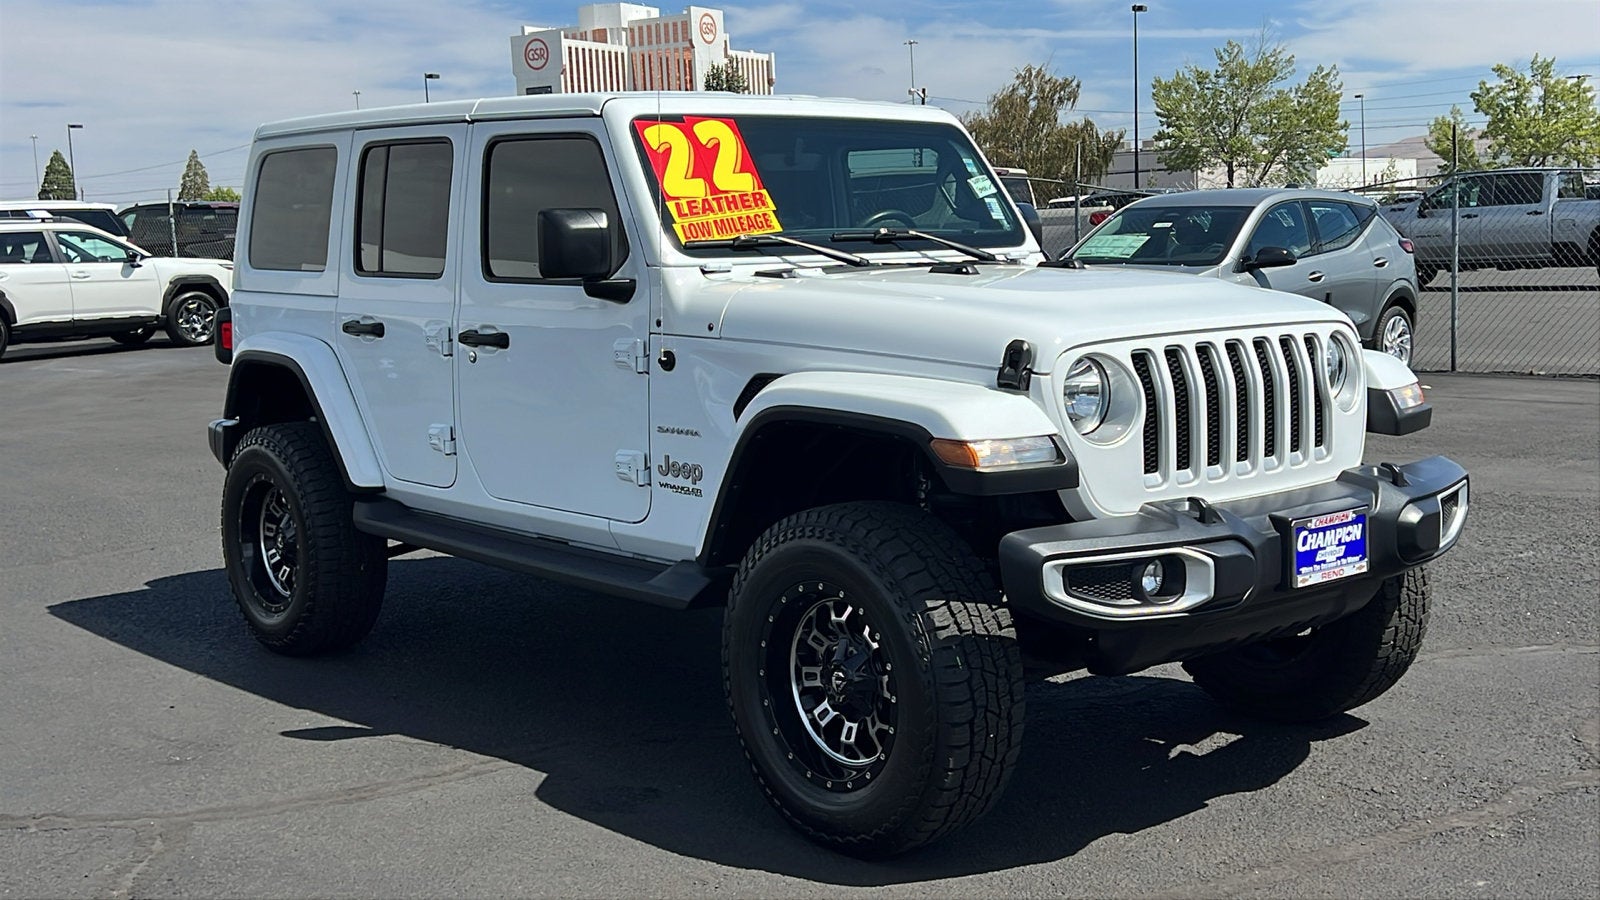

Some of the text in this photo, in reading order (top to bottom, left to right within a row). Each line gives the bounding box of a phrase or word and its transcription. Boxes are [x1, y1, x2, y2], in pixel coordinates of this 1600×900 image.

[701, 23, 715, 36] GSR
[527, 49, 546, 62] GSR
[643, 119, 757, 198] 22
[674, 191, 768, 219] LEATHER
[681, 212, 774, 241] LOW MILEAGE
[657, 425, 702, 437] SAHARA
[657, 454, 703, 485] Jeep
[658, 481, 702, 494] WRANGLER
[1314, 511, 1350, 527] CHAMPION
[1297, 523, 1363, 552] CHAMPION
[1321, 568, 1345, 580] RENO
